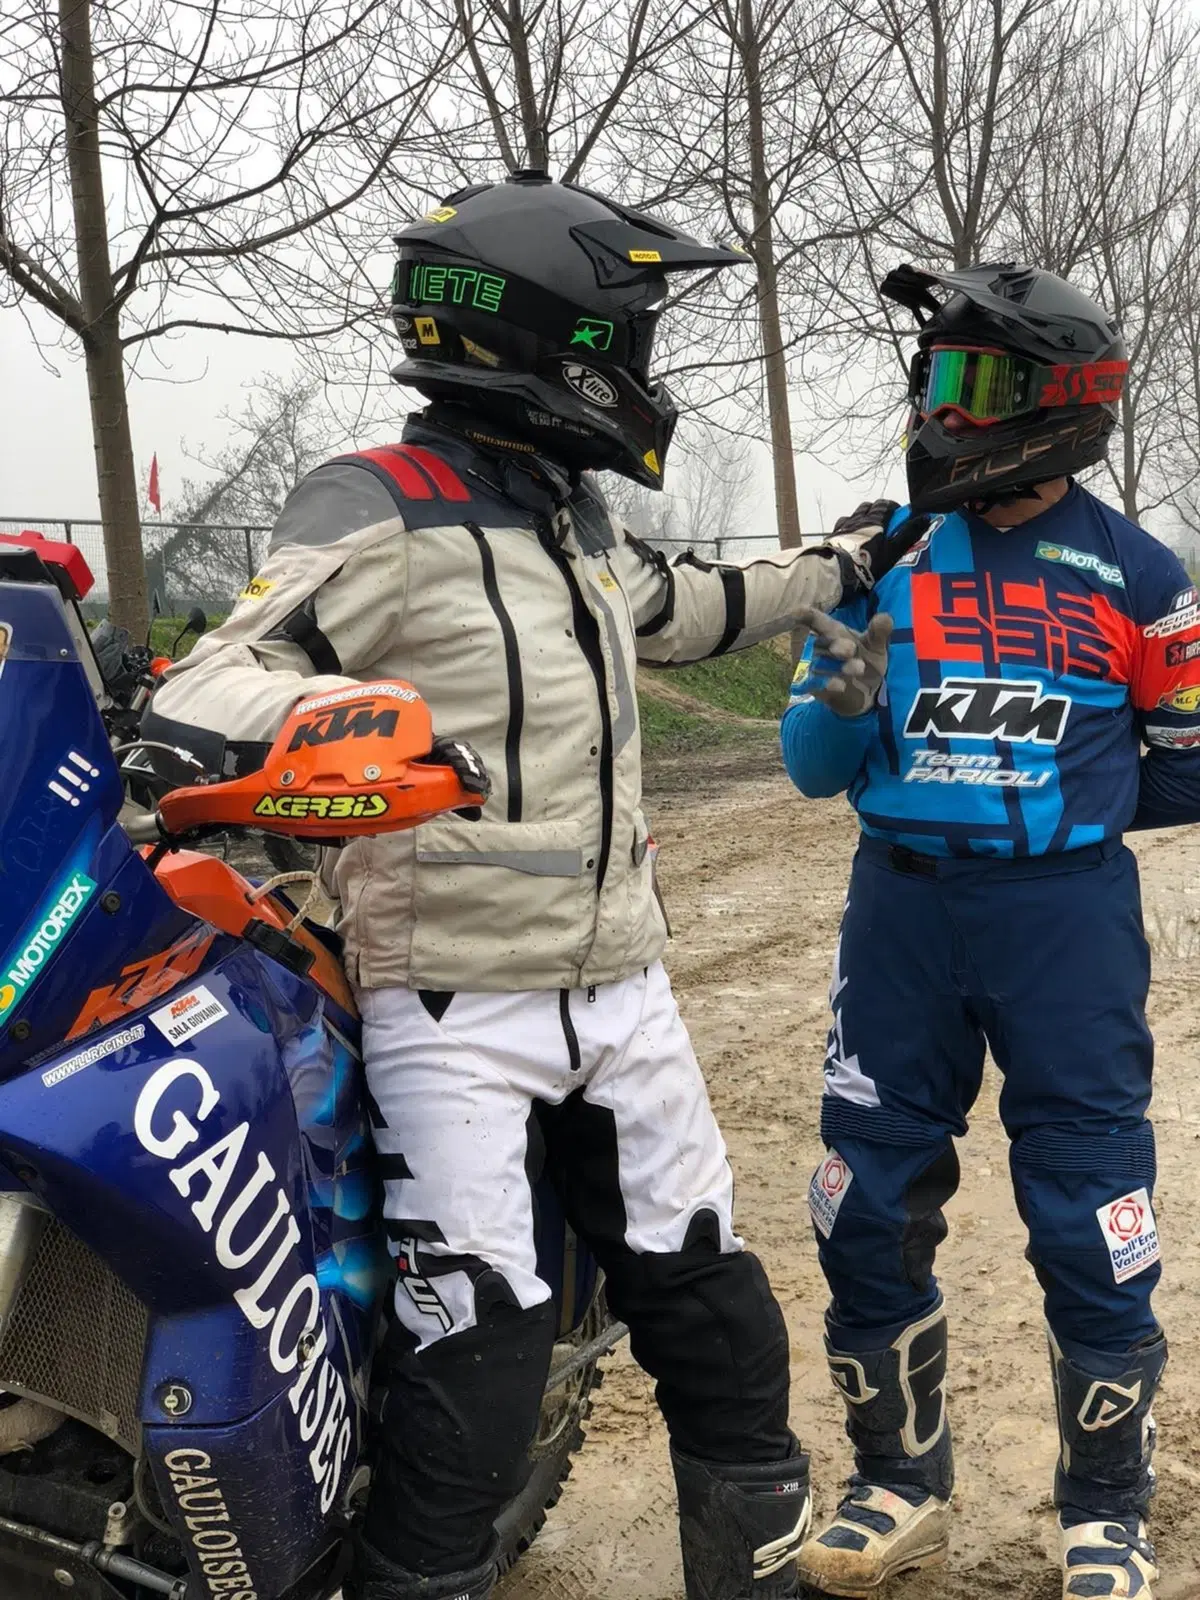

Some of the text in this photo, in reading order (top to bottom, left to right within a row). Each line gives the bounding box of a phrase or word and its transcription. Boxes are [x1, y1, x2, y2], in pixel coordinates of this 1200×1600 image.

[1060, 549, 1125, 585] MOTOREX
[286, 702, 400, 753] KTM
[904, 679, 1070, 743] KTM
[903, 768, 1053, 787] FARIOLI
[912, 750, 1002, 768] Team
[8, 877, 91, 987] MOTOREX
[168, 1002, 222, 1039] SALA GIOVANNI
[1112, 1231, 1156, 1260] Dall'Era
[1114, 1242, 1158, 1269] Valerio
[134, 1058, 352, 1514] GAULOISES
[164, 1448, 258, 1600] GAULOISES
